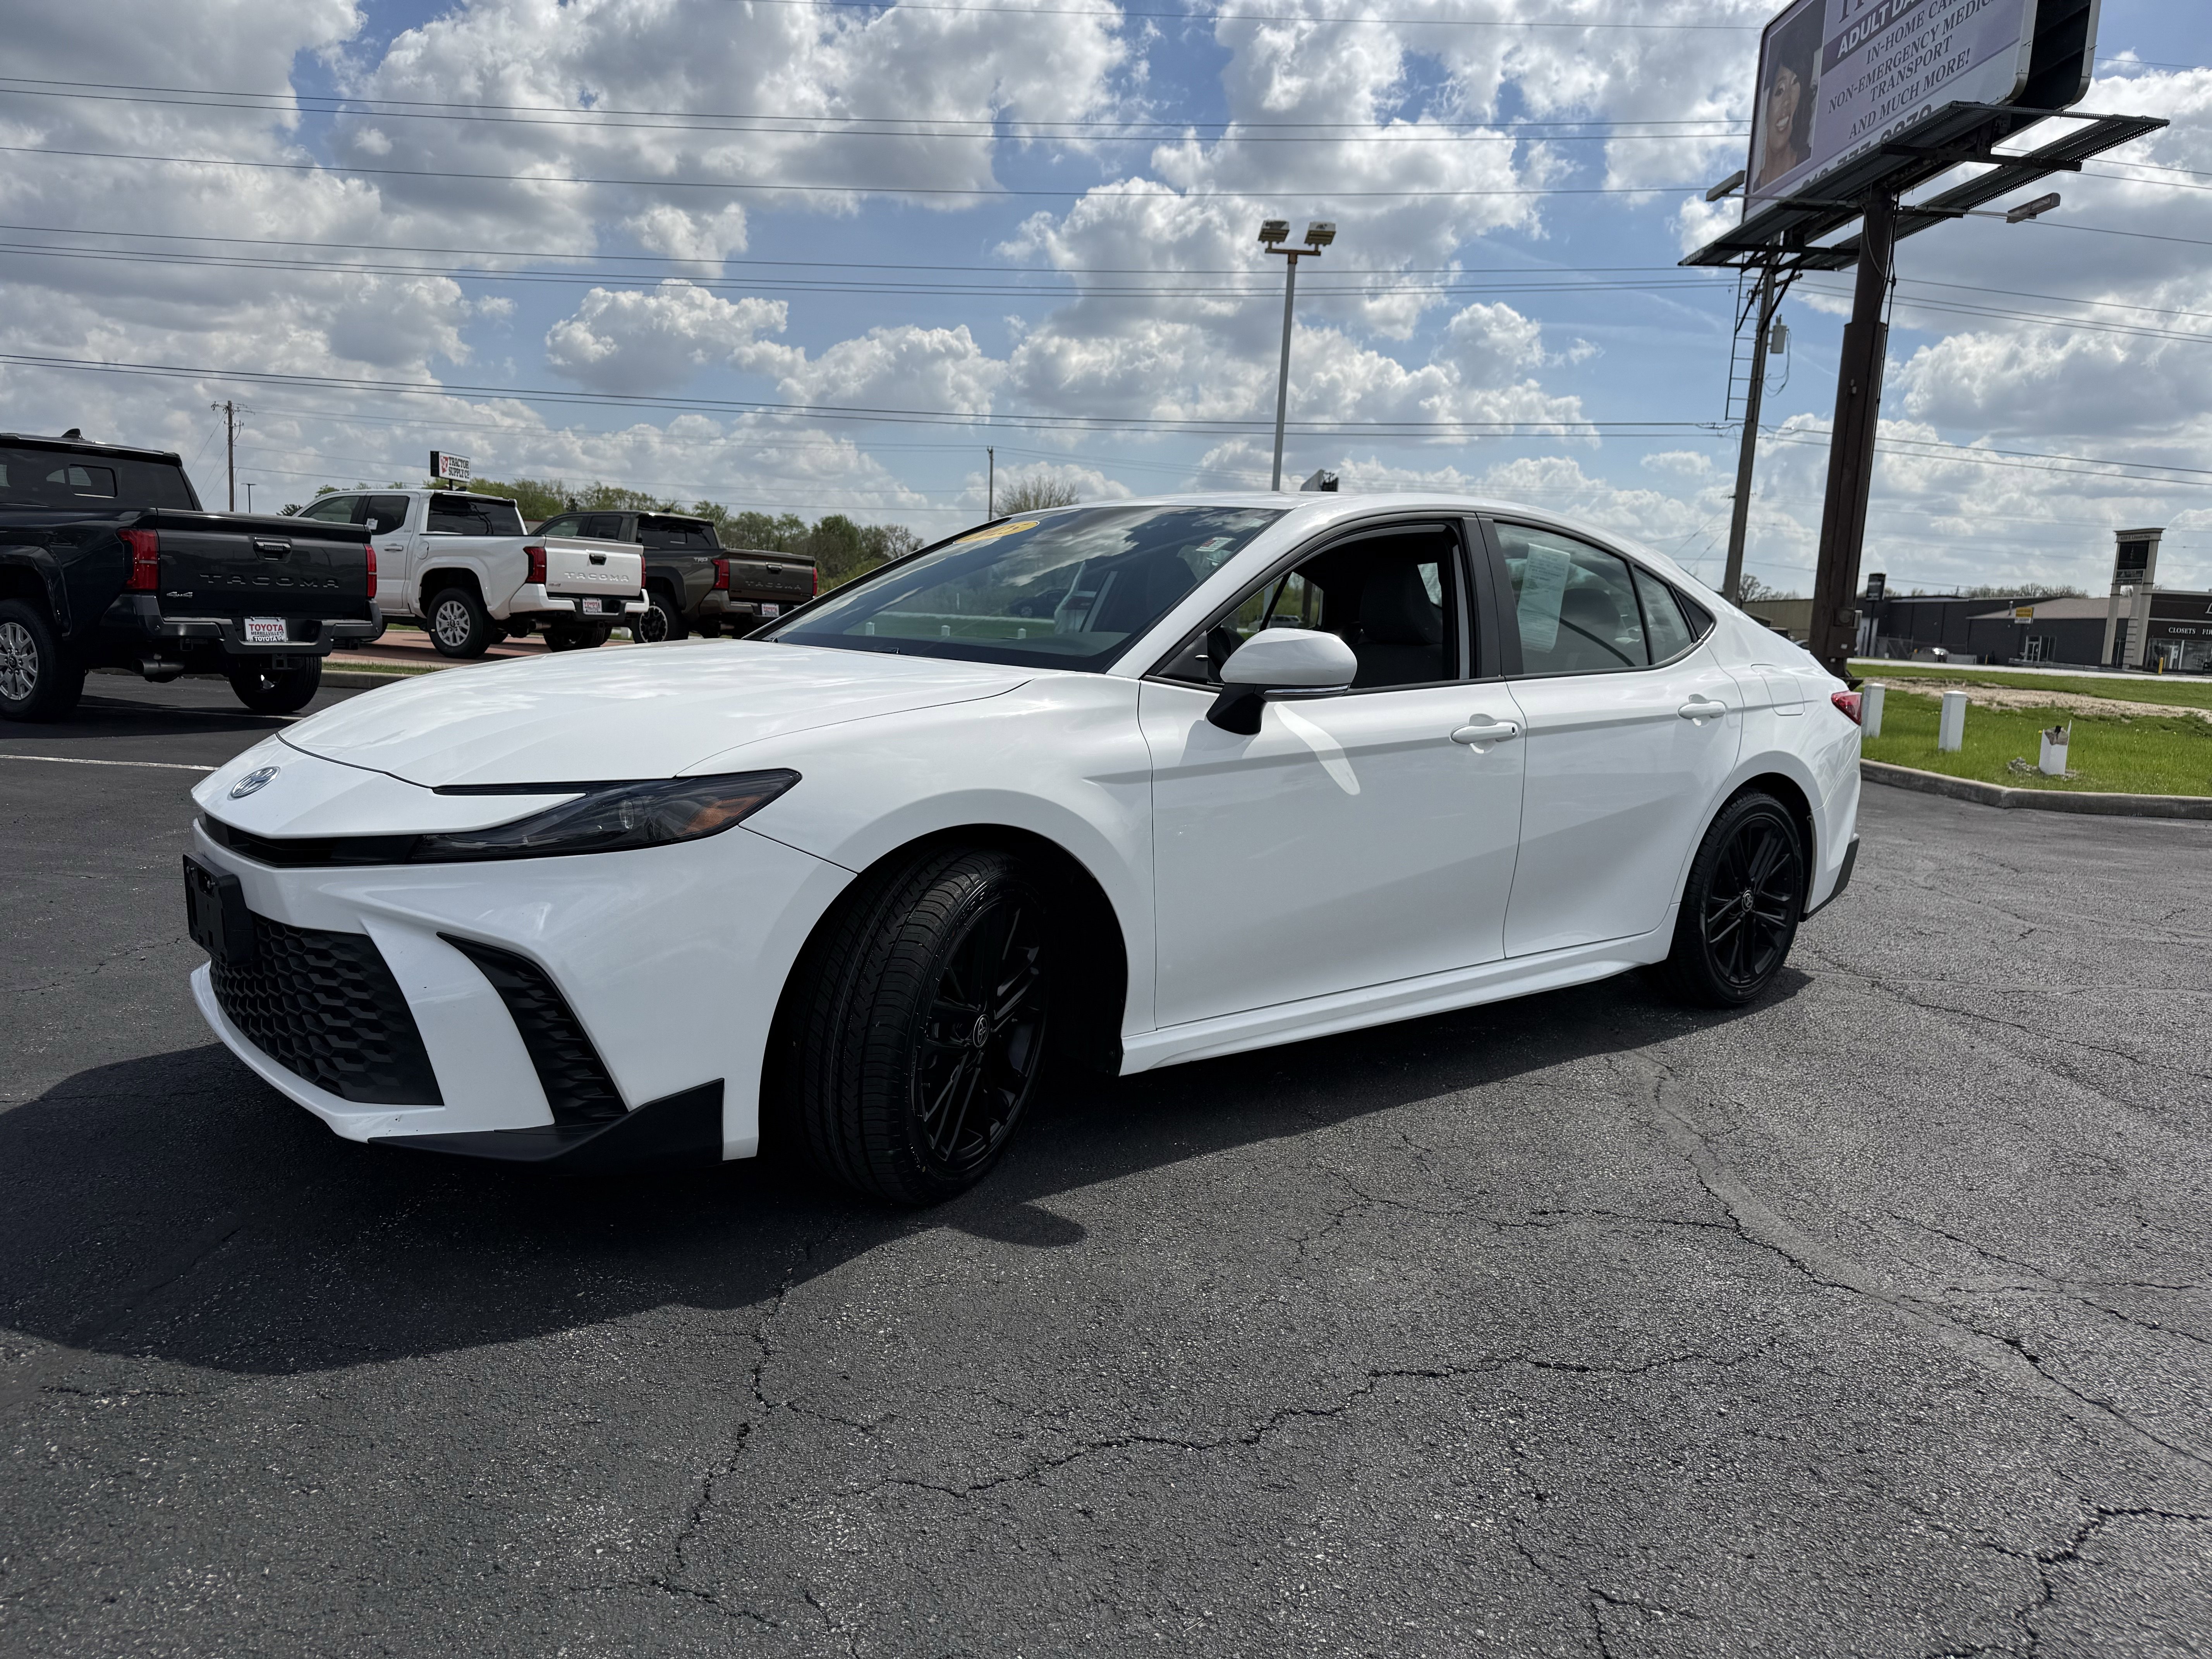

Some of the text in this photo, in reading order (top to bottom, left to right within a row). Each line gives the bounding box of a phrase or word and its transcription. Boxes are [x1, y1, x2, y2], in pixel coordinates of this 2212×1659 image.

[1837, 2, 1889, 58] ADULT
[1867, 10, 1925, 65] IN-HOME
[1828, 24, 1939, 114] NON-EMERGENCY
[1870, 34, 1952, 102] TRANSPORT
[1849, 48, 1970, 139] AND MUCH MORE!
[449, 457, 469, 469] TRACTOR
[449, 467, 464, 478] SUPPLY
[199, 574, 339, 588] TACOMA
[564, 572, 629, 582] TACOMA
[745, 580, 801, 590] TACOMA
